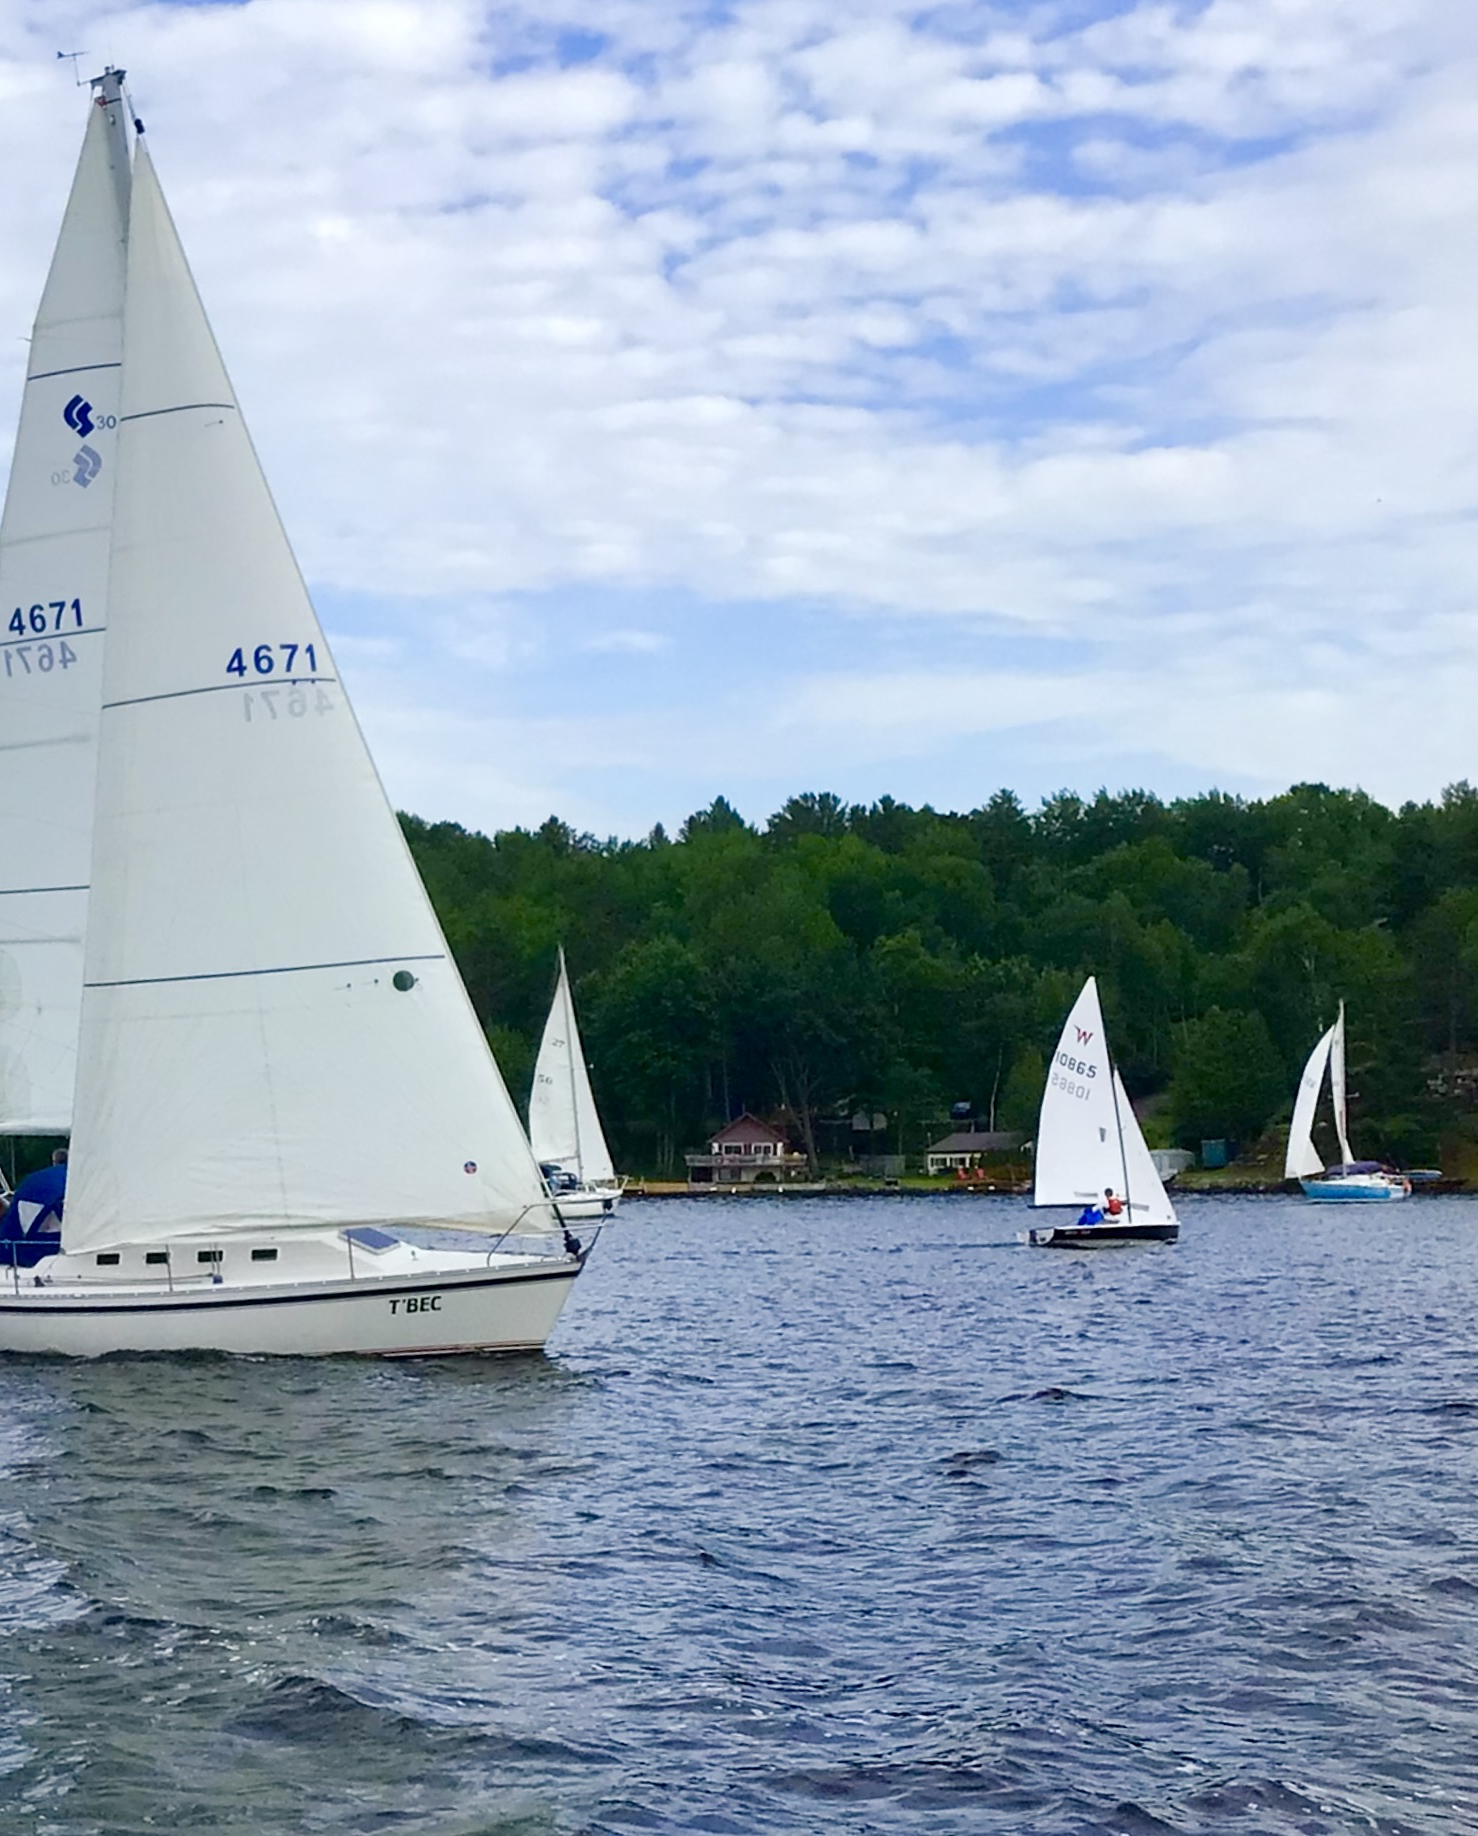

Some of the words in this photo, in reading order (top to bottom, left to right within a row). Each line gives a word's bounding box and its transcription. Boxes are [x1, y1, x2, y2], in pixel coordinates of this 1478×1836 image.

[96, 415, 117, 430] 30
[9, 598, 83, 635] 4671
[226, 643, 317, 677] 4671
[1055, 1051, 1097, 1078] 10865
[388, 1296, 442, 1314] T'BEC
